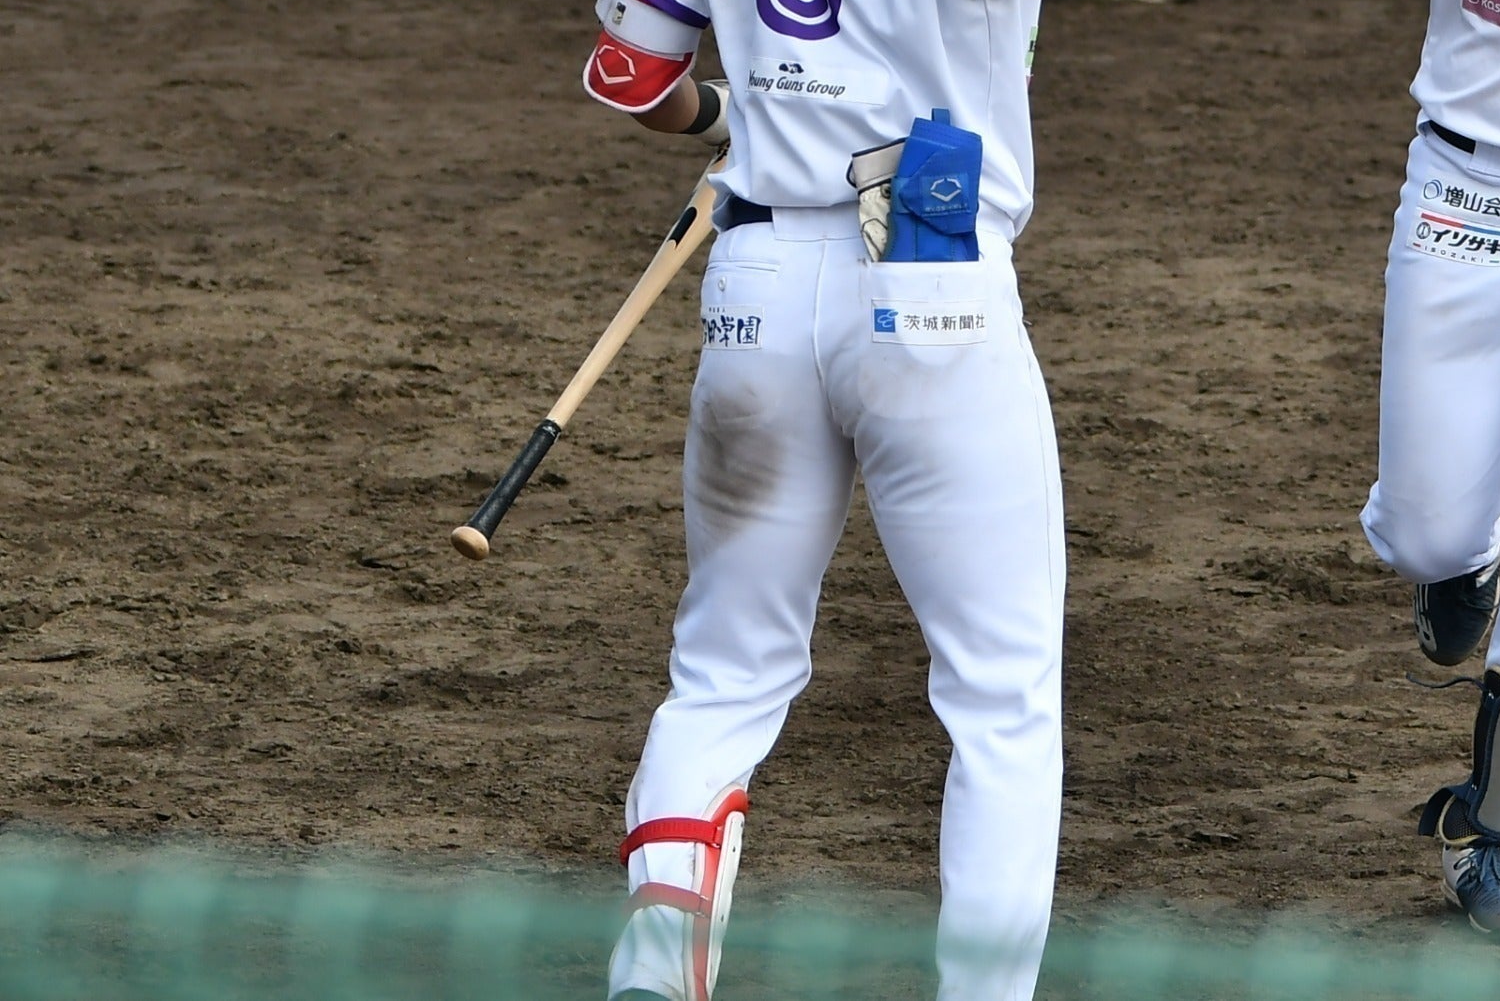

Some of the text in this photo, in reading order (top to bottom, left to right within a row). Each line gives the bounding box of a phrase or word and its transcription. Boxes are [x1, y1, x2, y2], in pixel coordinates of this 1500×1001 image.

[748, 69, 846, 99] Young Guns Group
[1424, 245, 1484, 265] ISOZAKI
[903, 313, 986, 332] 茨城新聞社
